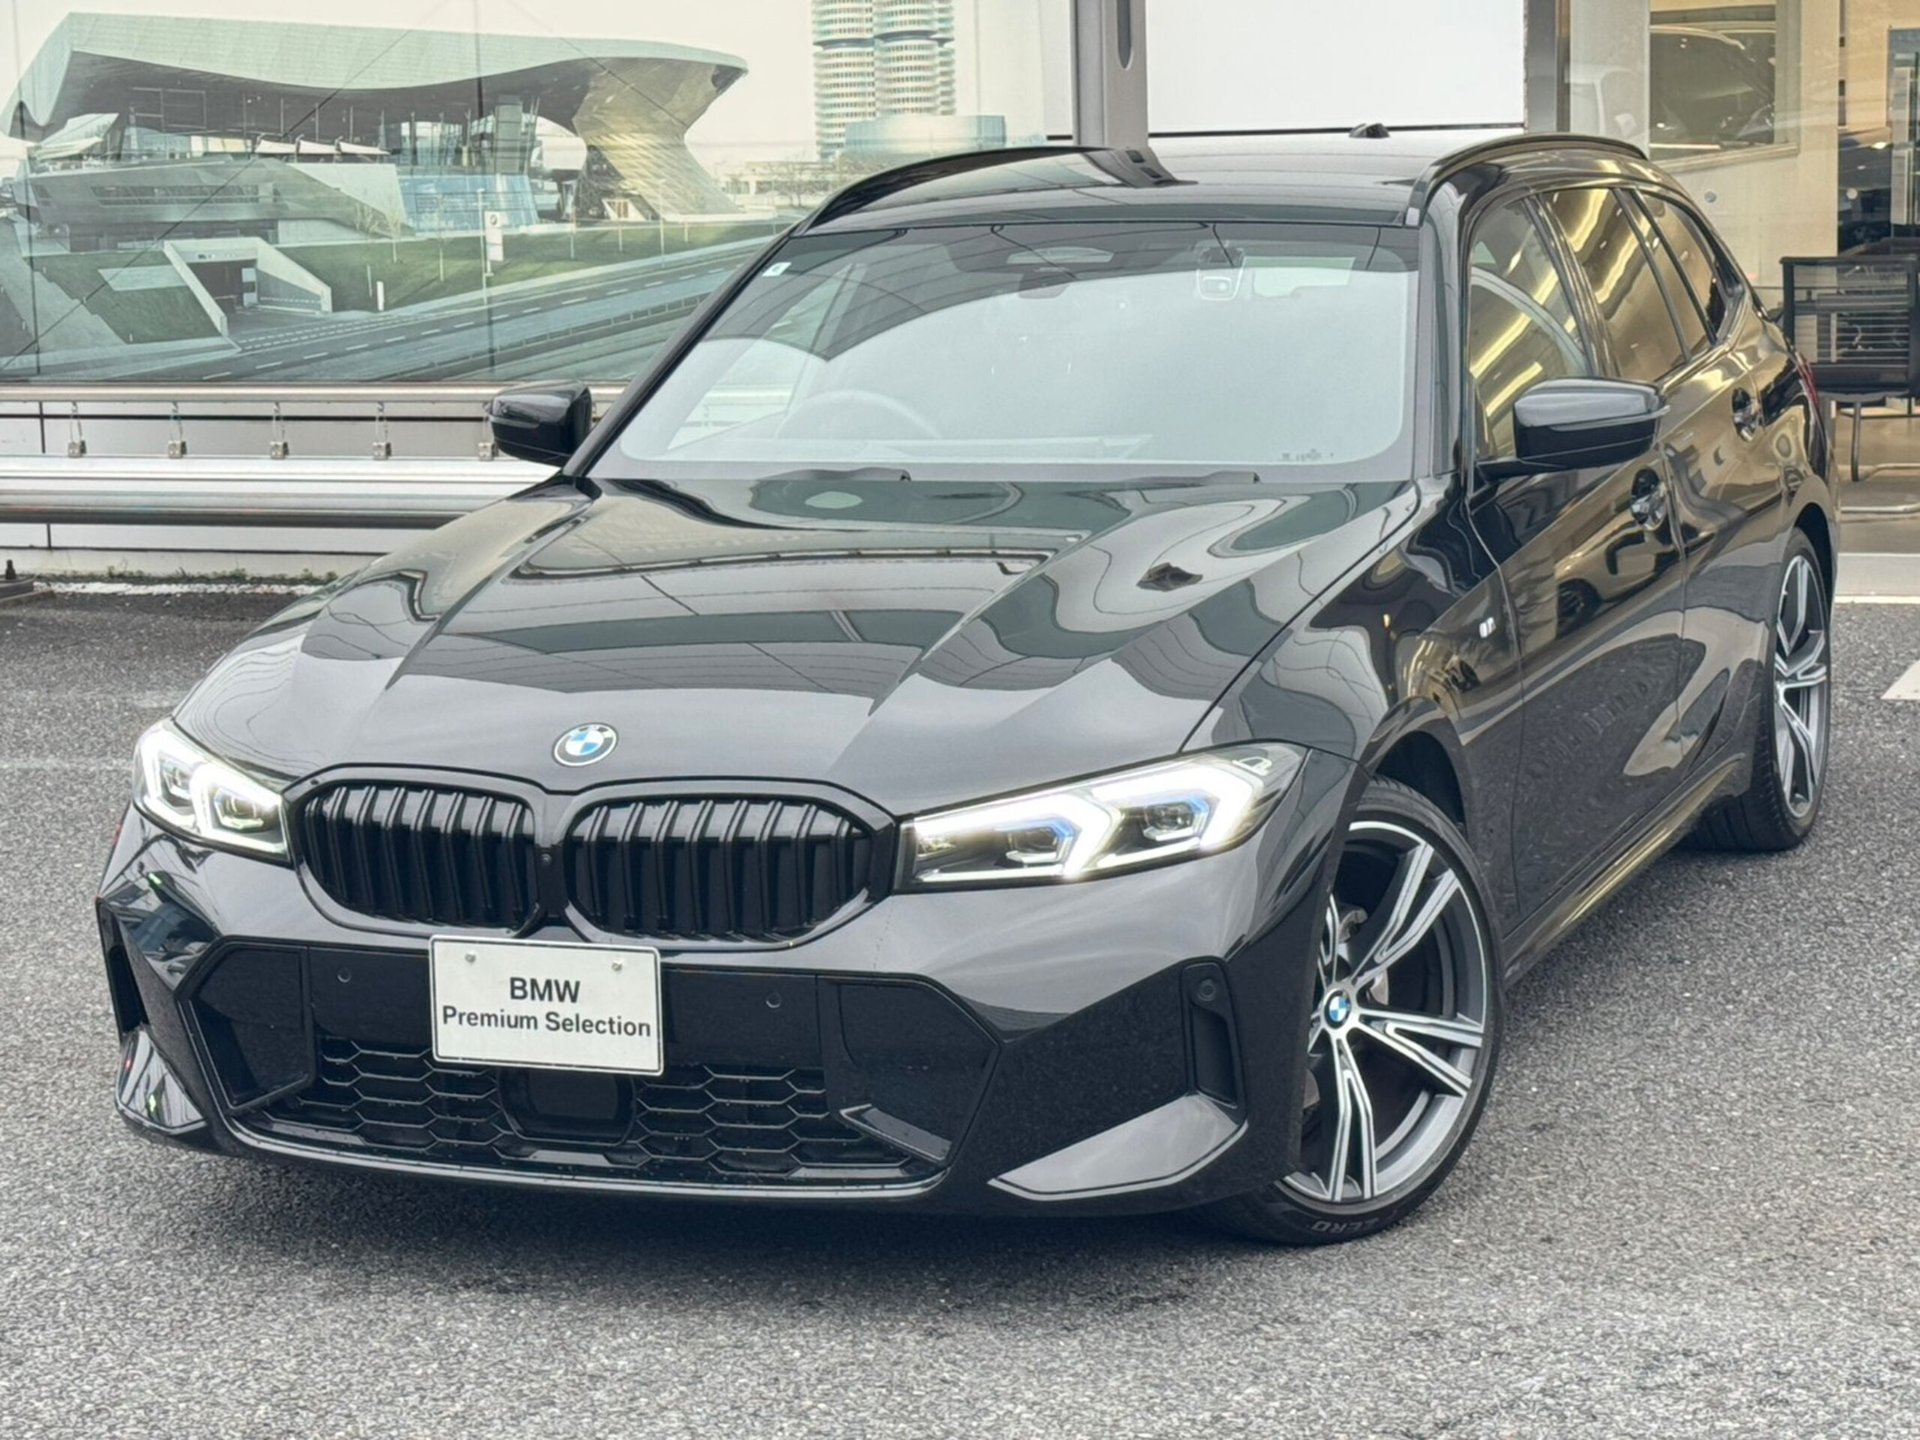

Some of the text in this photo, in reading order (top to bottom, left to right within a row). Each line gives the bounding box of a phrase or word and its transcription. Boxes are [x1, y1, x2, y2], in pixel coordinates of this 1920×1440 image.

[510, 977, 580, 1003] BMW
[442, 1005, 651, 1037] Premium Selection
